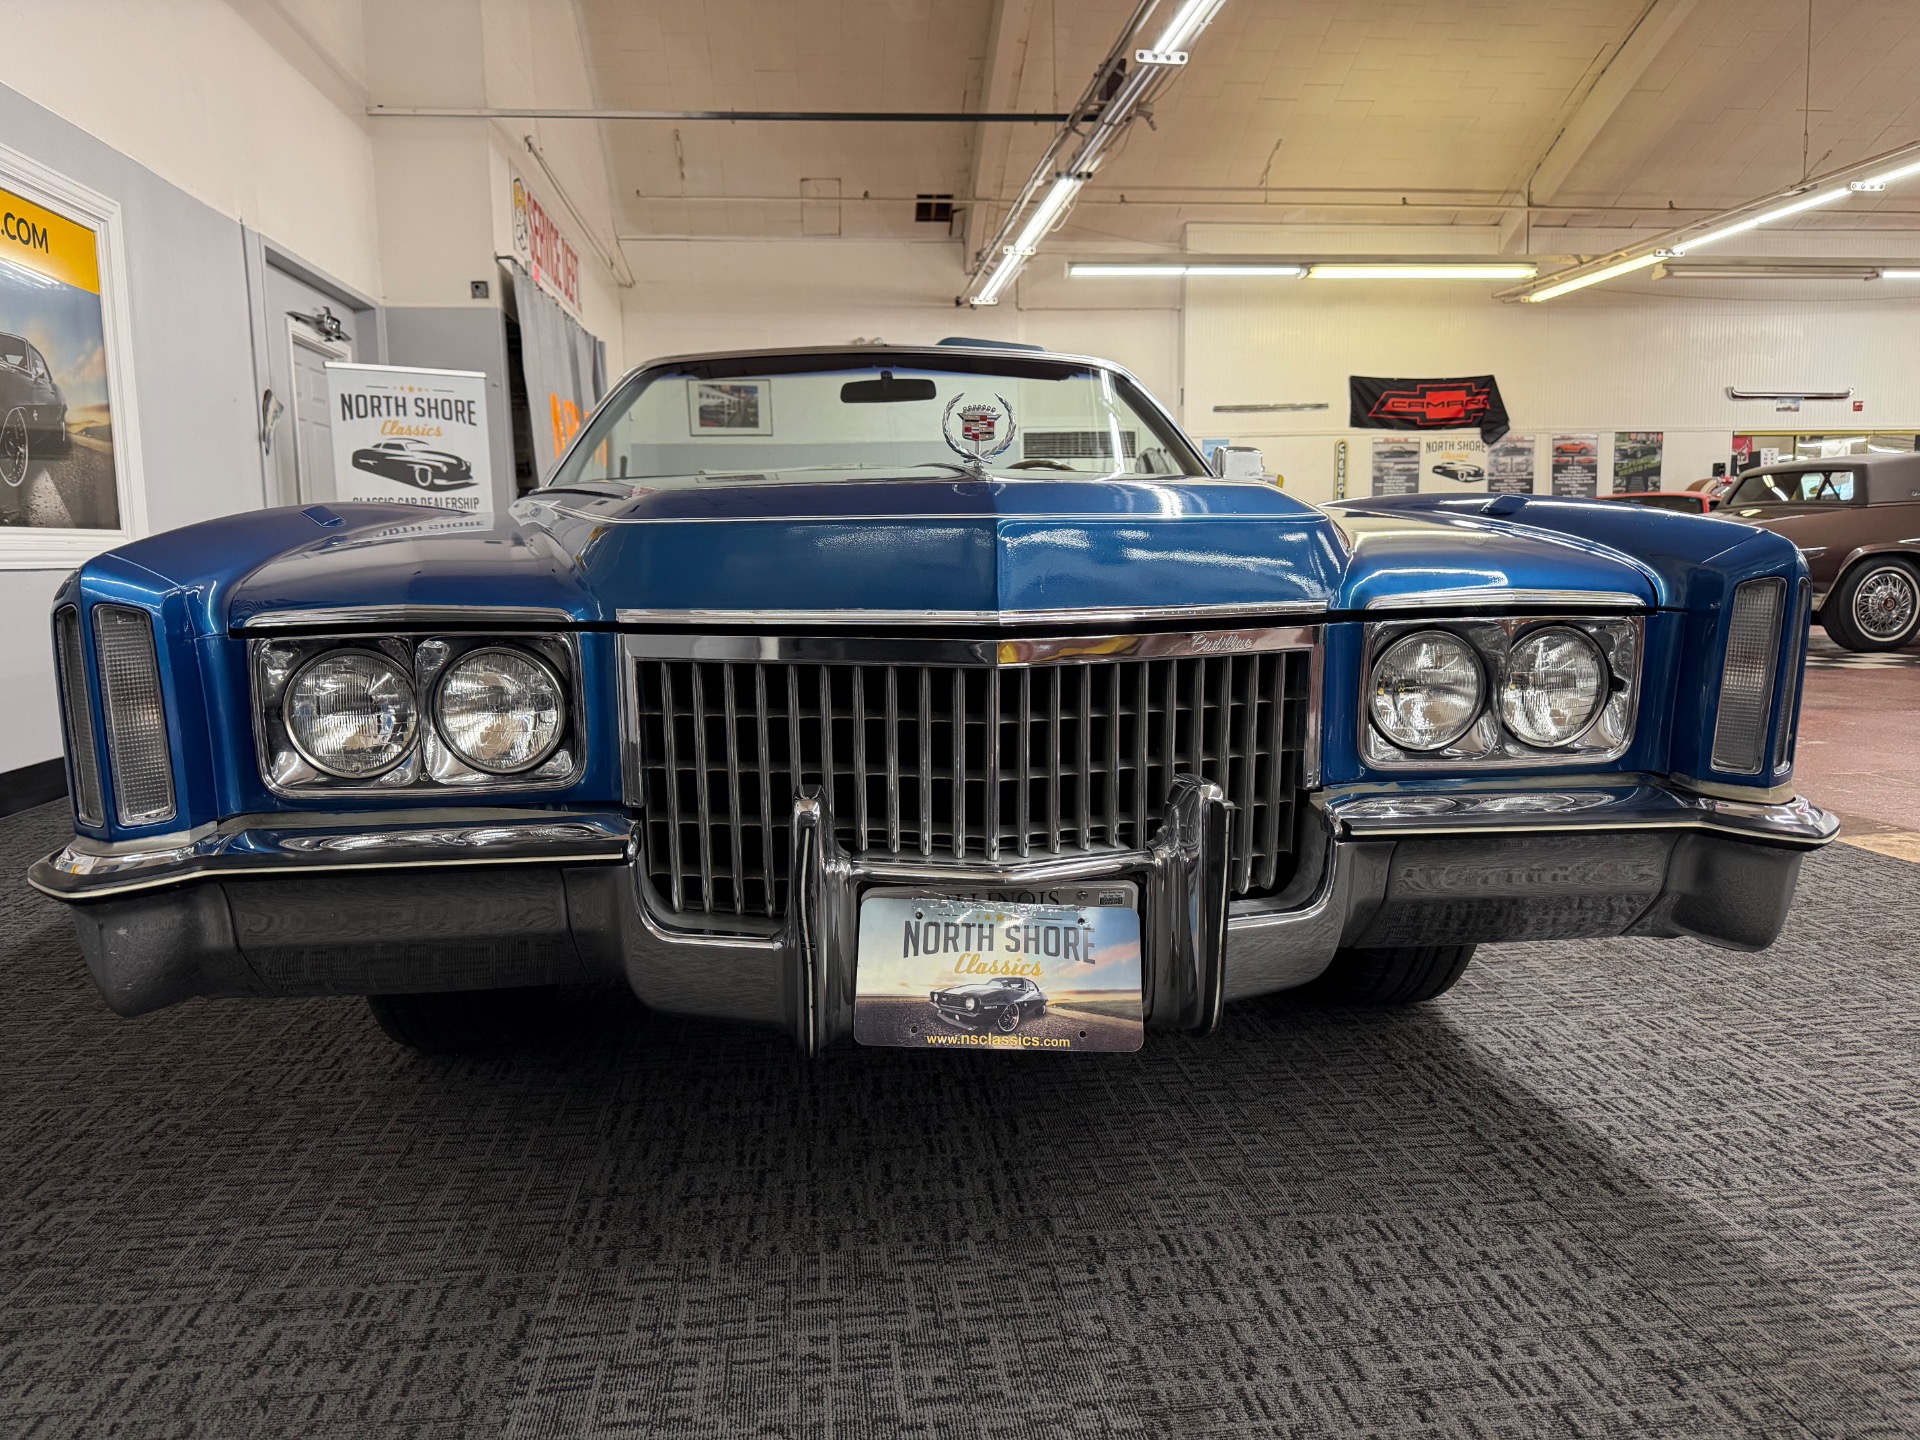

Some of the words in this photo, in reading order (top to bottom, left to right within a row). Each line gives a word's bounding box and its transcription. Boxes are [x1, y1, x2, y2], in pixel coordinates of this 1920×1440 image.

[340, 393, 407, 421] NORTH
[414, 397, 478, 426] SHORE
[380, 420, 443, 437] Classics
[1426, 441, 1455, 454] NORTH
[1192, 633, 1252, 653] Cadillac
[903, 920, 994, 958] NORTH
[1005, 923, 1096, 965] SHORE
[953, 952, 1044, 976] Classics
[926, 1032, 1071, 1048] www.nsclassics.com
